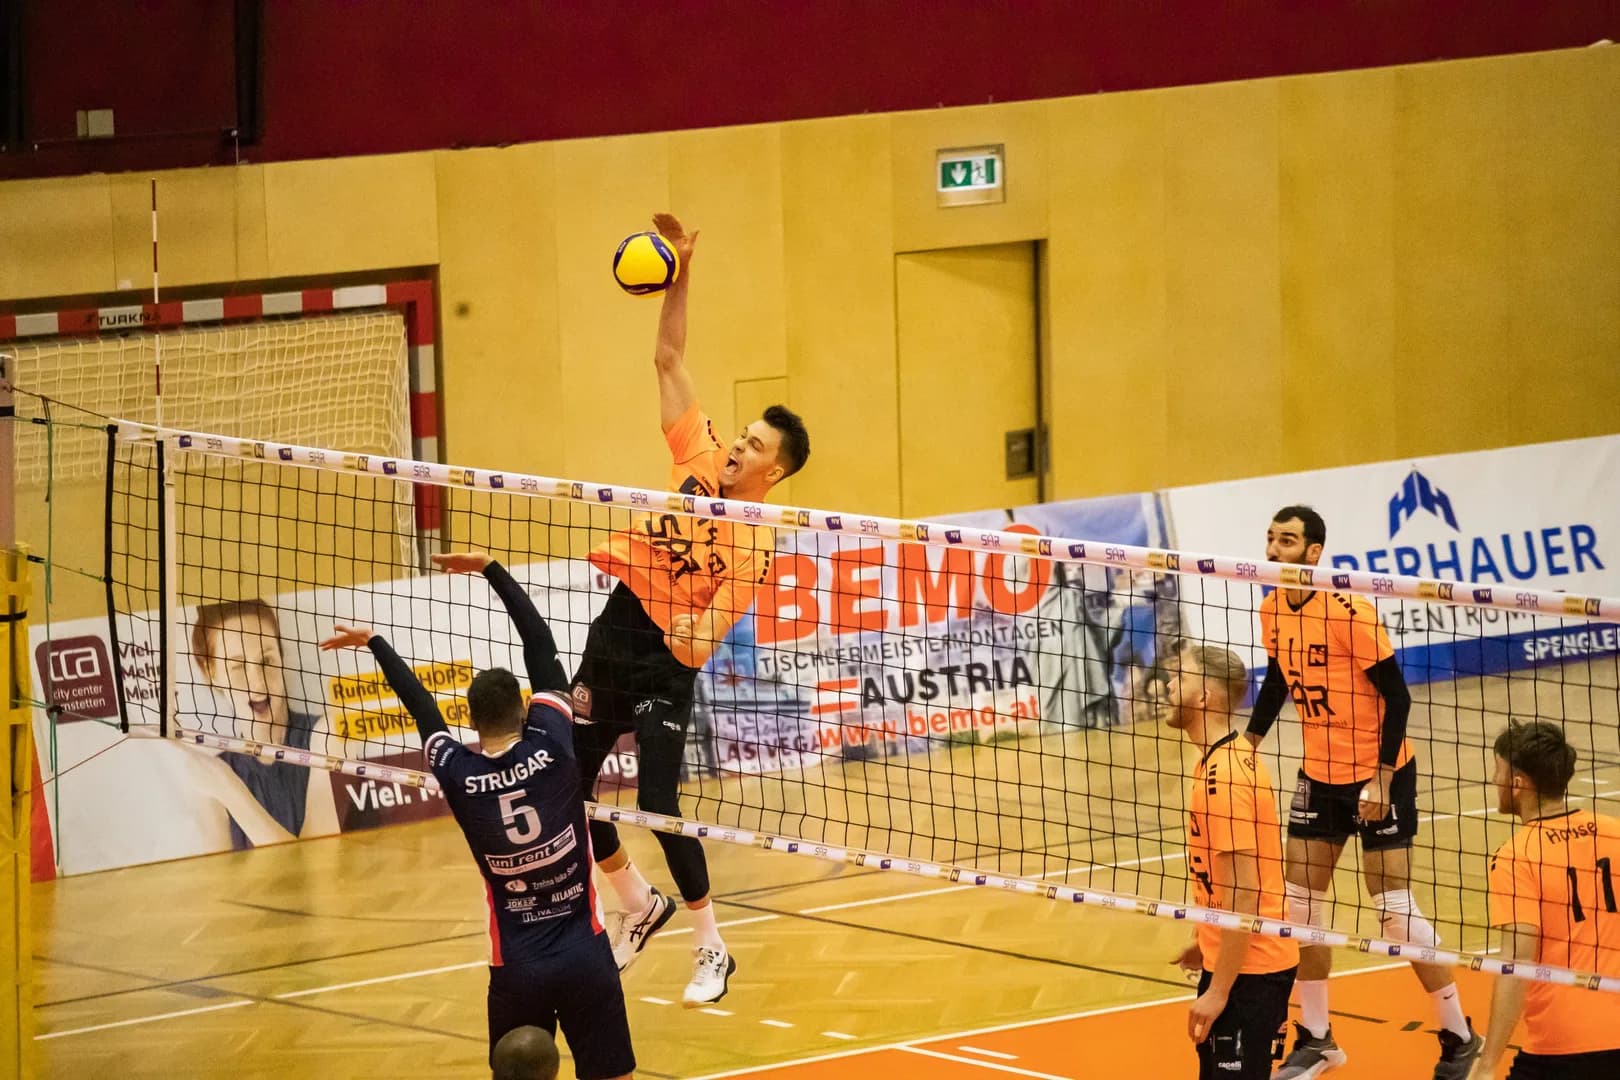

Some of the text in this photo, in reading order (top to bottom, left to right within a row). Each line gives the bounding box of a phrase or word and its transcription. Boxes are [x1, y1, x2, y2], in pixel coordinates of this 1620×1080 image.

[754, 524, 1051, 645] BEMO
[759, 621, 1064, 676] TISCHLERMEISTERMONTAGEN
[1522, 626, 1620, 660] SPENGLE
[72, 684, 103, 698] center
[333, 676, 376, 700] Rund
[418, 666, 470, 688] HOPS
[861, 657, 1034, 708] AUSTRIA
[60, 697, 106, 712] mstetten
[816, 695, 1040, 748] www.bemo.at
[339, 720, 348, 737] 2
[355, 712, 417, 735] STUND
[464, 749, 555, 794] STRUGAR
[345, 780, 412, 811] Viel.
[498, 790, 543, 845] 5
[491, 846, 551, 868] uni rent
[551, 882, 584, 903] ATLANTIC
[1567, 857, 1618, 923] 11
